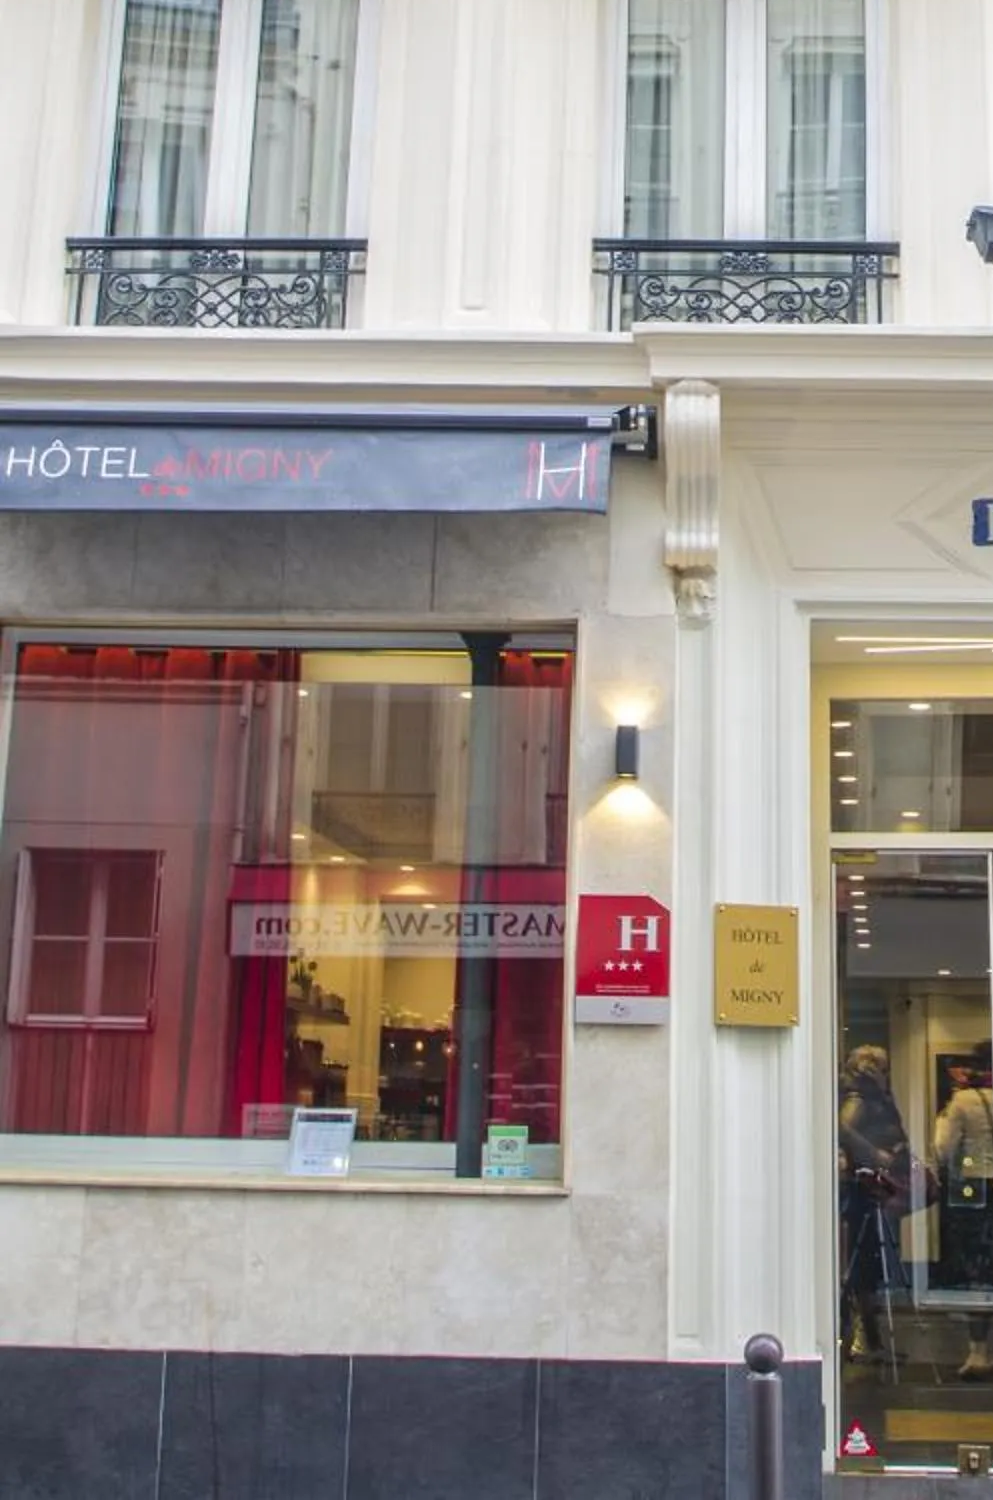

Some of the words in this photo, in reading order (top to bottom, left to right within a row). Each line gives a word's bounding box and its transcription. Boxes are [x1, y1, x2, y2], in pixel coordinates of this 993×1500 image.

[5, 438, 151, 479] HÔTEL
[183, 445, 334, 483] MIGNY
[616, 914, 663, 952] H
[732, 925, 784, 945] HÔTEL
[731, 987, 785, 1006] MIGNY
